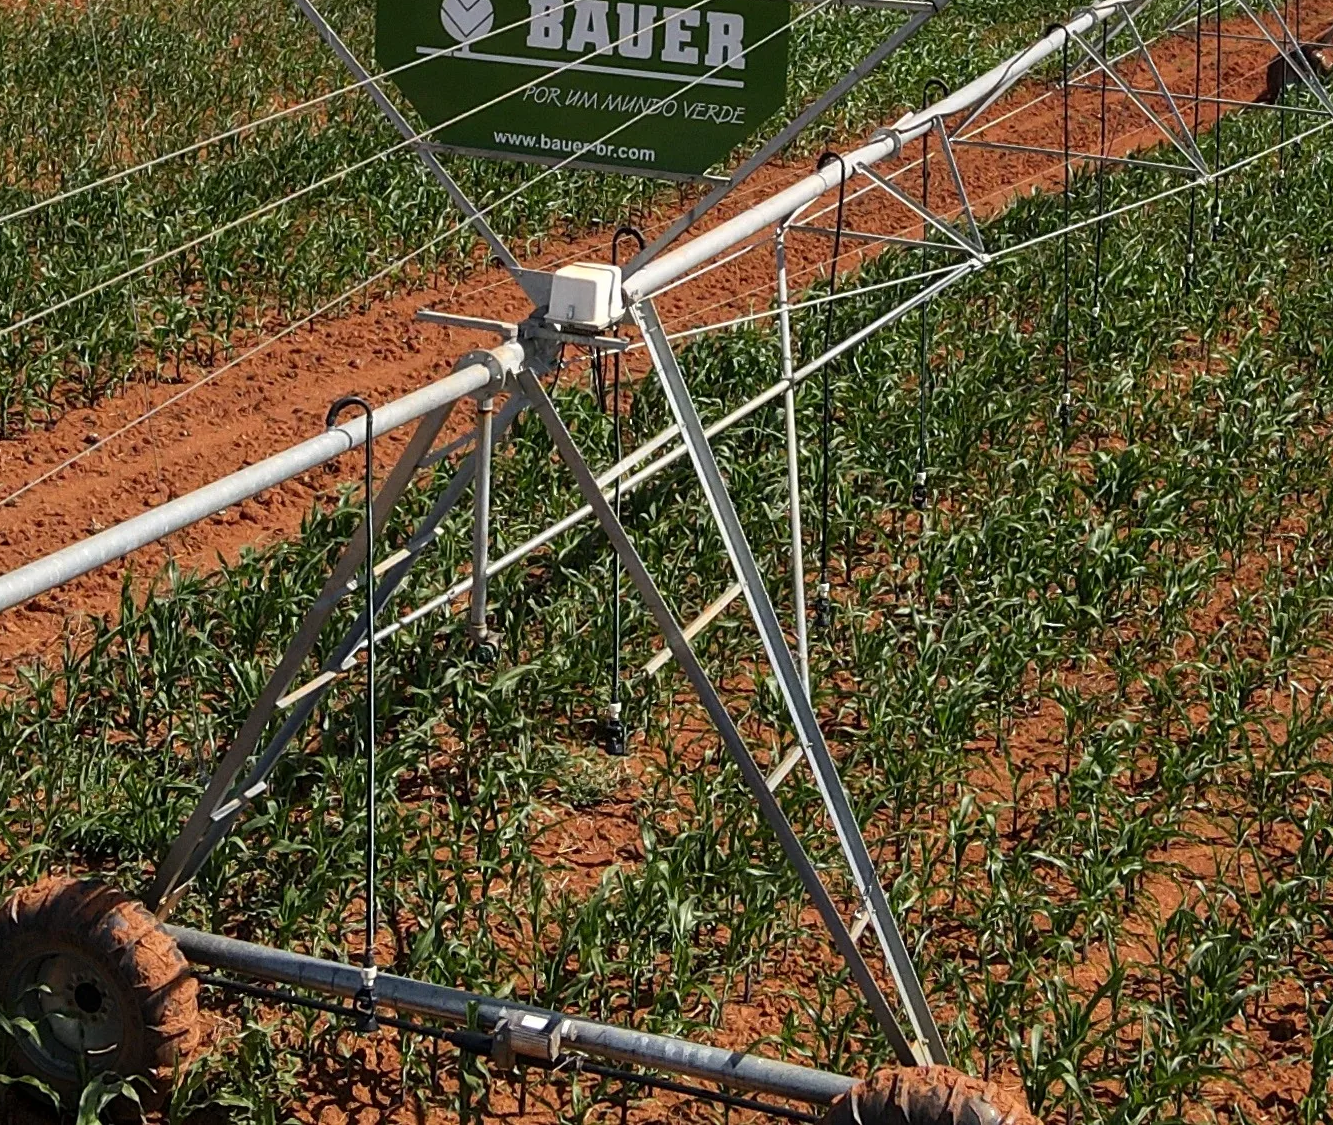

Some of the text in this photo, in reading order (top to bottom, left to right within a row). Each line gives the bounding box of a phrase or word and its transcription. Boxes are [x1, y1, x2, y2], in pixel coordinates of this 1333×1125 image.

[522, 85, 746, 125] POR UM MUNDO VERDE
[493, 130, 656, 162] www.bauer-br.com
